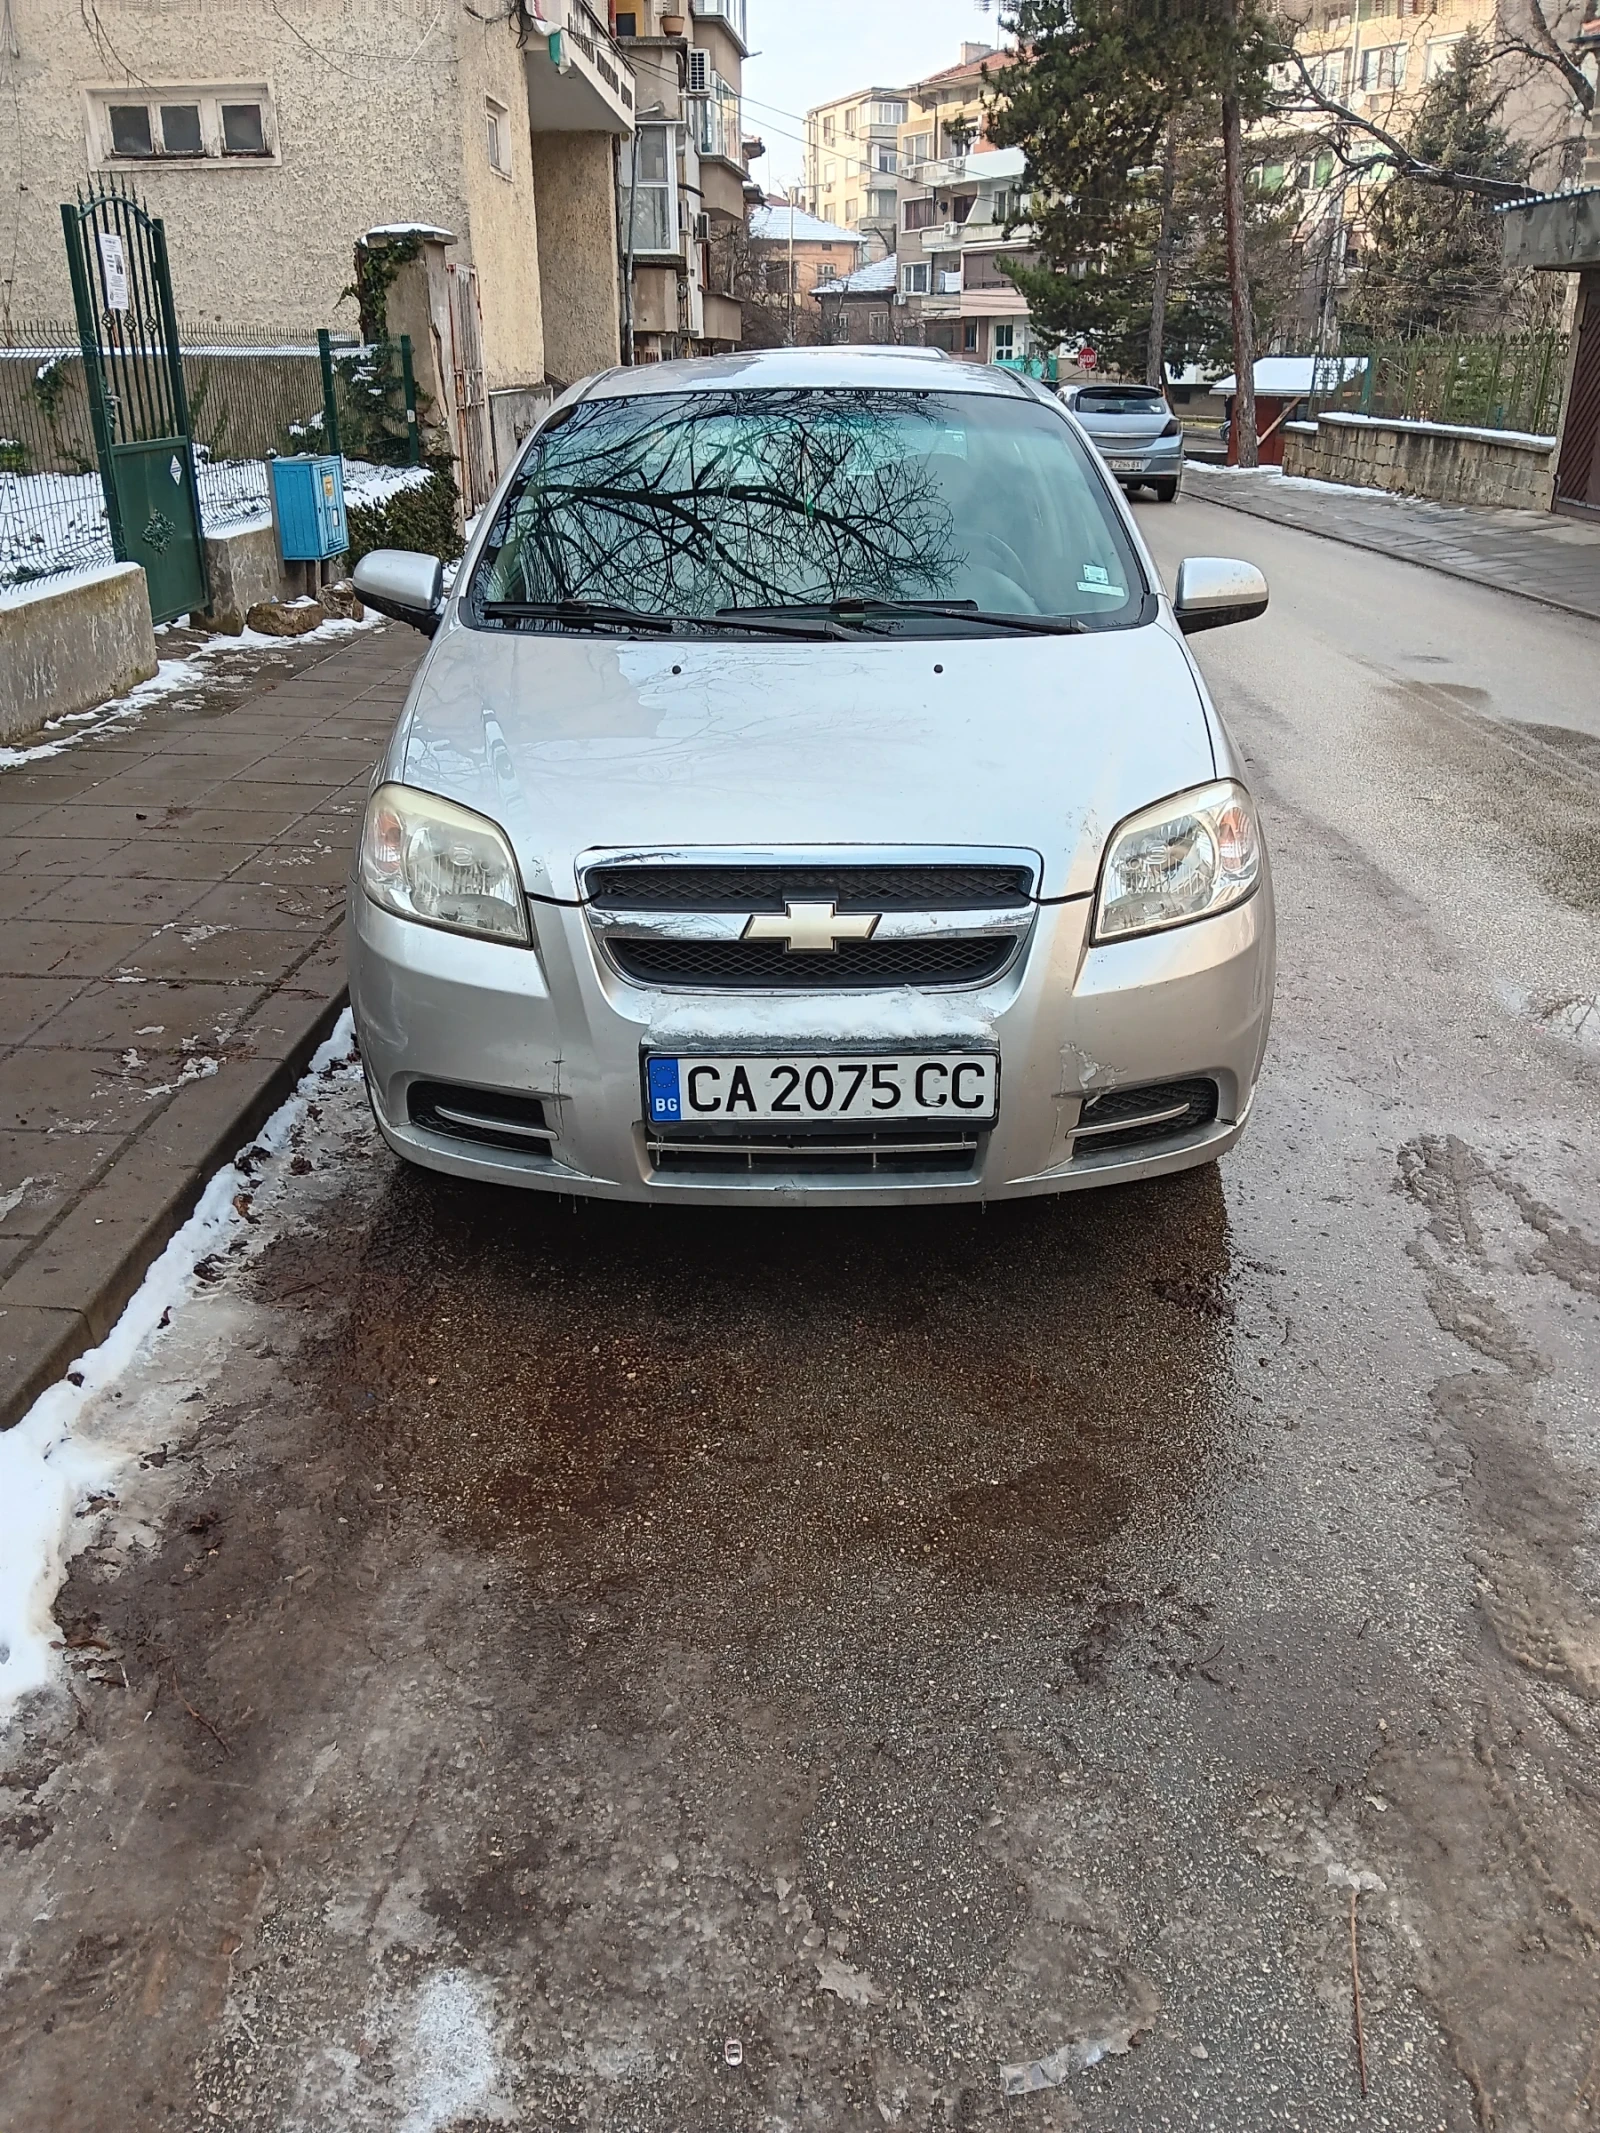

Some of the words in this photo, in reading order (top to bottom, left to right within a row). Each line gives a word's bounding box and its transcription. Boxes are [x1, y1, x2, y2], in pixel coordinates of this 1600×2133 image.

[687, 1065, 757, 1112] CA
[770, 1064, 901, 1112] 2075
[915, 1062, 985, 1109] CC
[655, 1098, 678, 1112] BG
